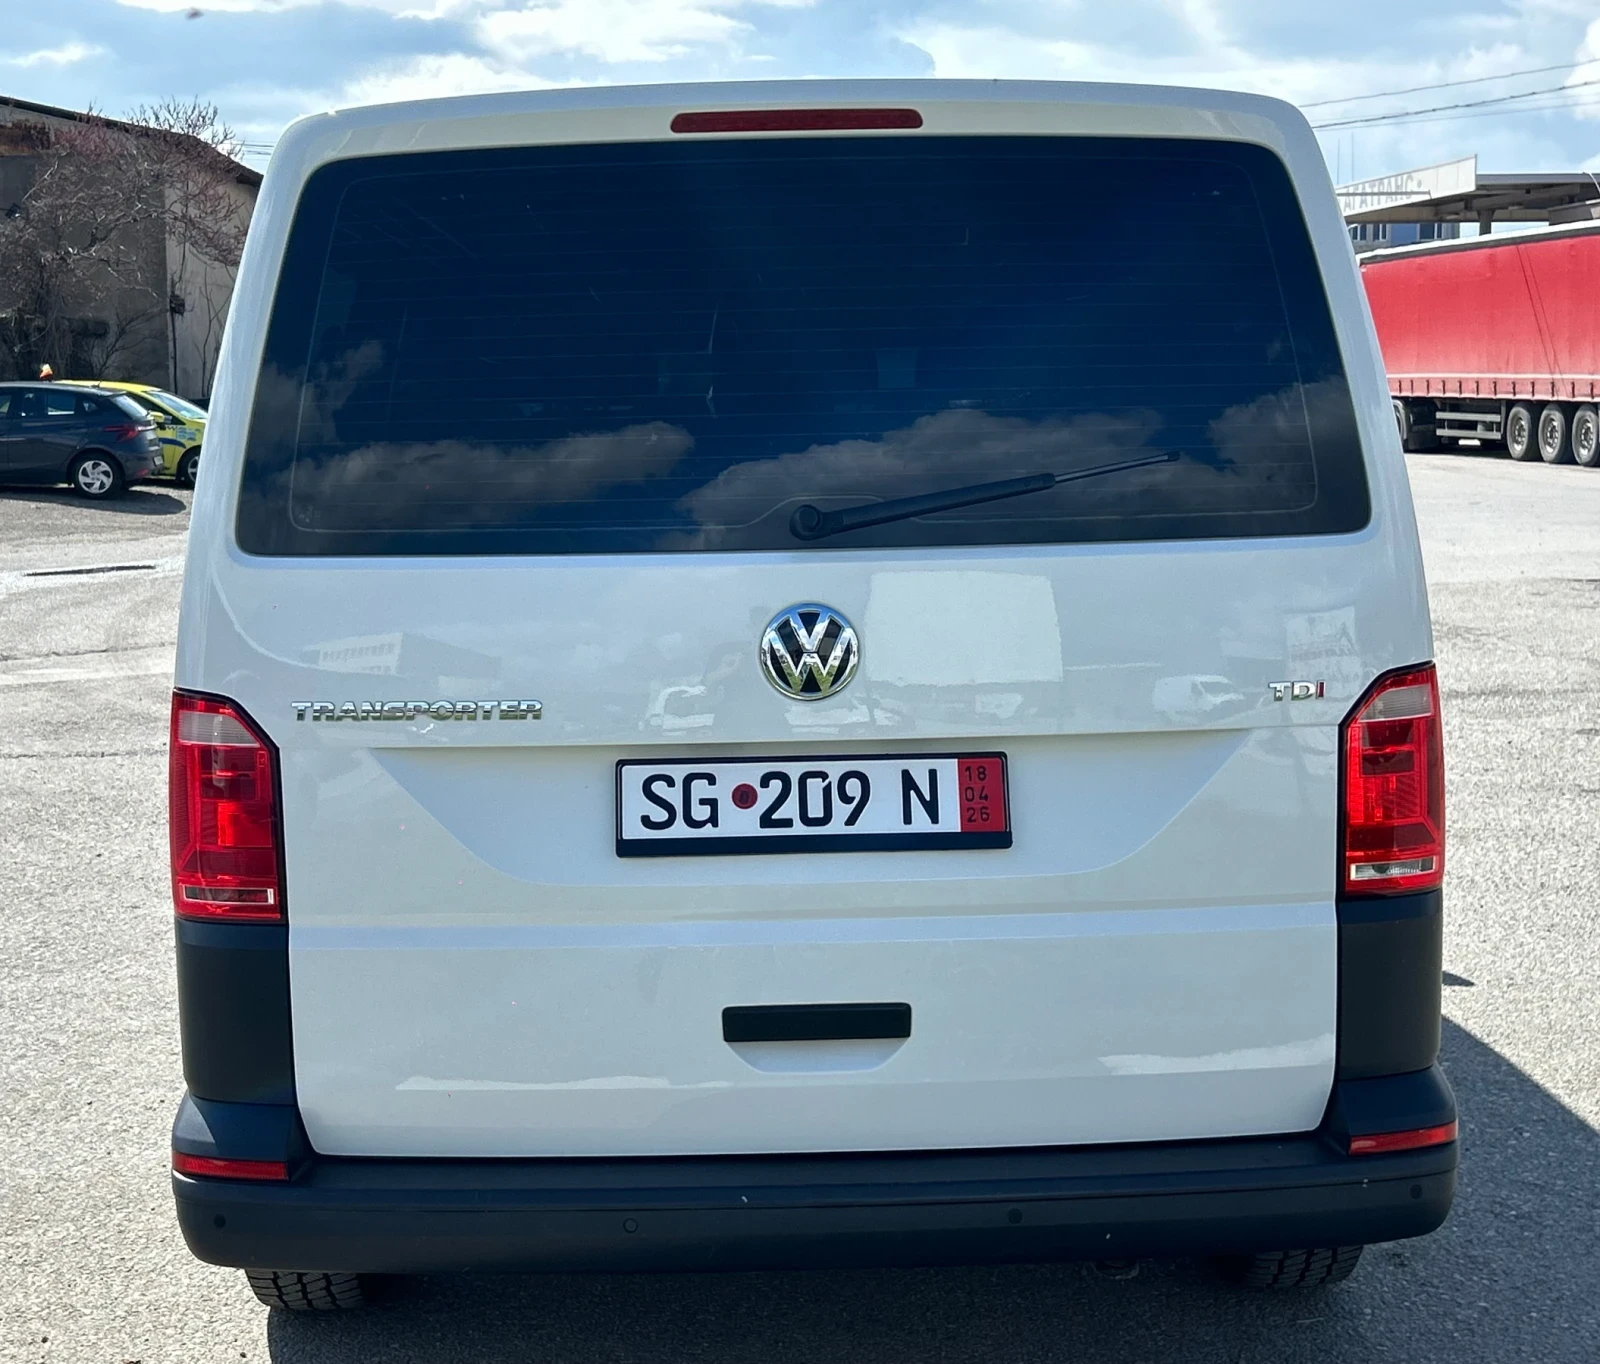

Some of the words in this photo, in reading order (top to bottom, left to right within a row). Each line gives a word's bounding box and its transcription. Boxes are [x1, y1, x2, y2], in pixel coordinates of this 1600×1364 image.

[761, 603, 860, 701] VW
[1268, 680, 1325, 701] TDI
[291, 700, 543, 721] TRANSPORTER
[964, 765, 987, 782] 18
[640, 772, 719, 830] SG
[759, 770, 871, 828] 209
[901, 768, 940, 825] N
[964, 785, 989, 802] 04
[966, 806, 990, 823] 26
